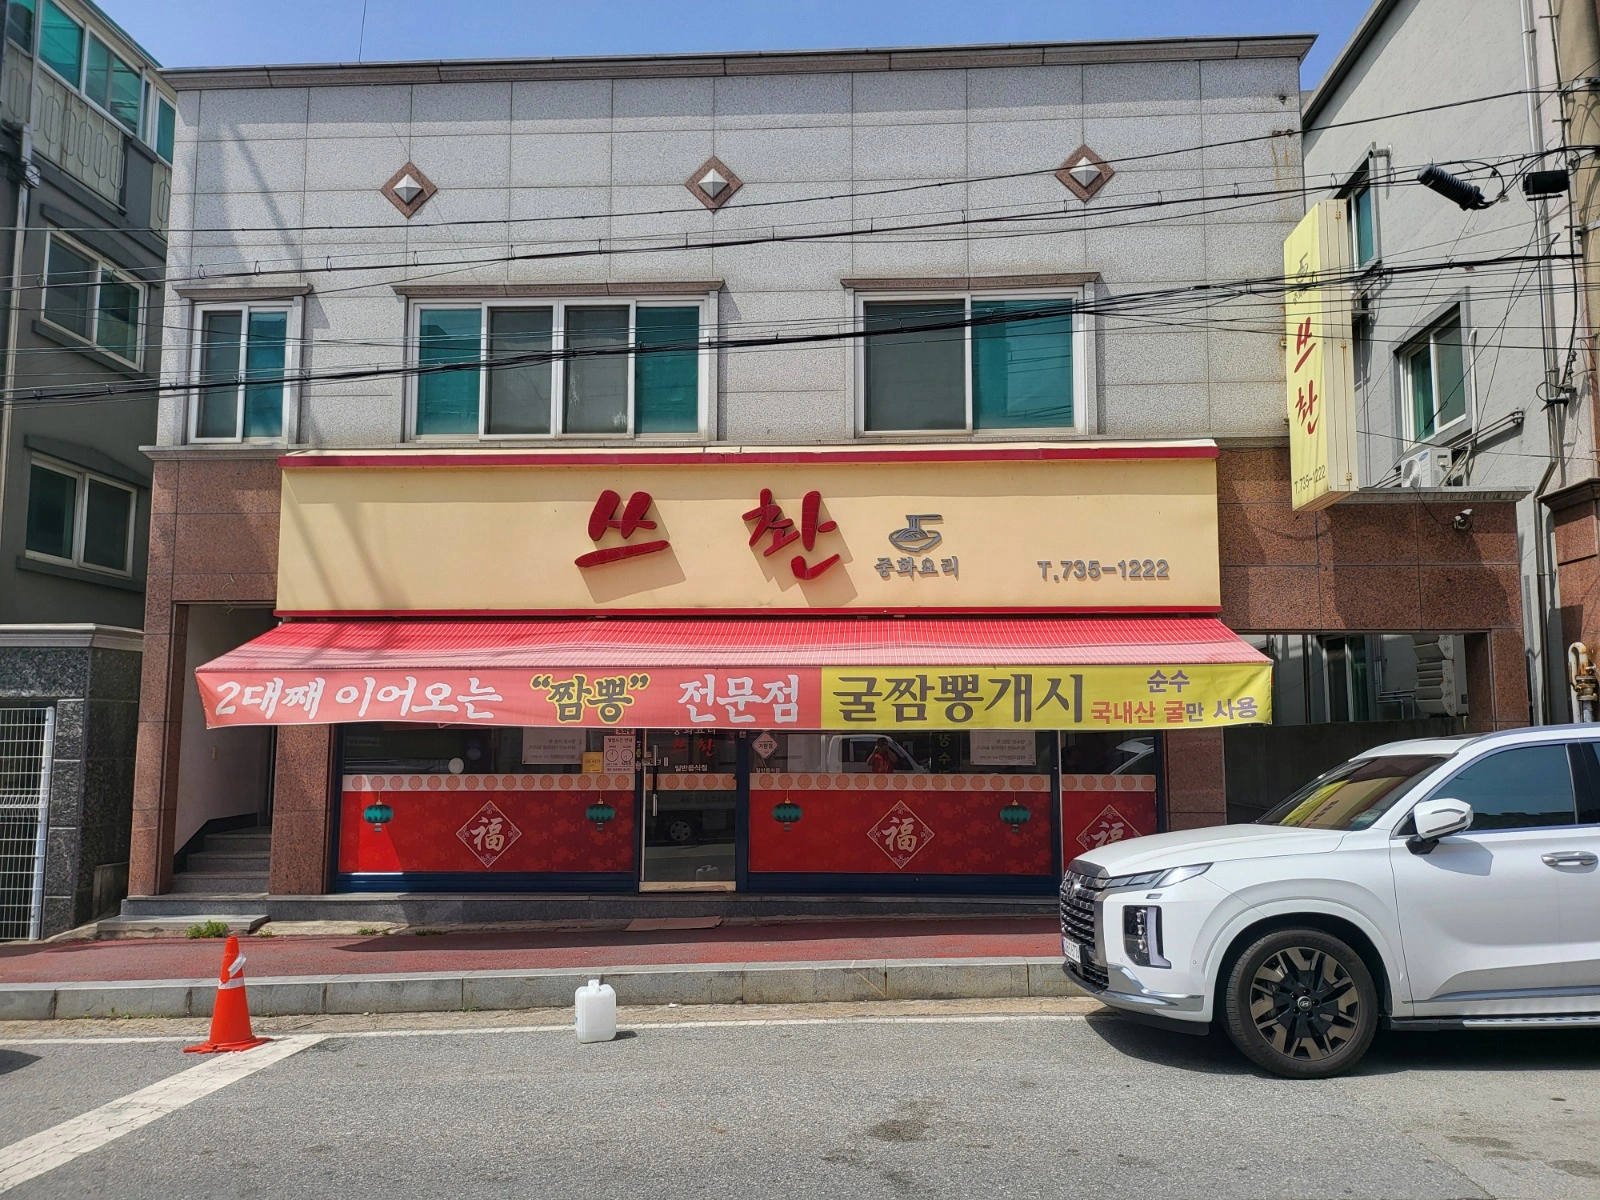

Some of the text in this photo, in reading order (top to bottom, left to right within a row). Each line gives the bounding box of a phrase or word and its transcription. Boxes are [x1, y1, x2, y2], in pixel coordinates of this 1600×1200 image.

[874, 555, 960, 580] 중화요리
[1036, 558, 1170, 582] T.735-1222
[1146, 669, 1191, 693] 순수
[215, 675, 326, 720] 2대째
[335, 675, 503, 720] 이어오는
[677, 673, 800, 724] 전문점
[832, 673, 1084, 723] 굴짬뽕개시
[1090, 696, 1258, 725] 국내산 굴만 사용
[674, 764, 708, 772] 일반음식점
[469, 816, 505, 852] 福
[880, 816, 918, 853] 福
